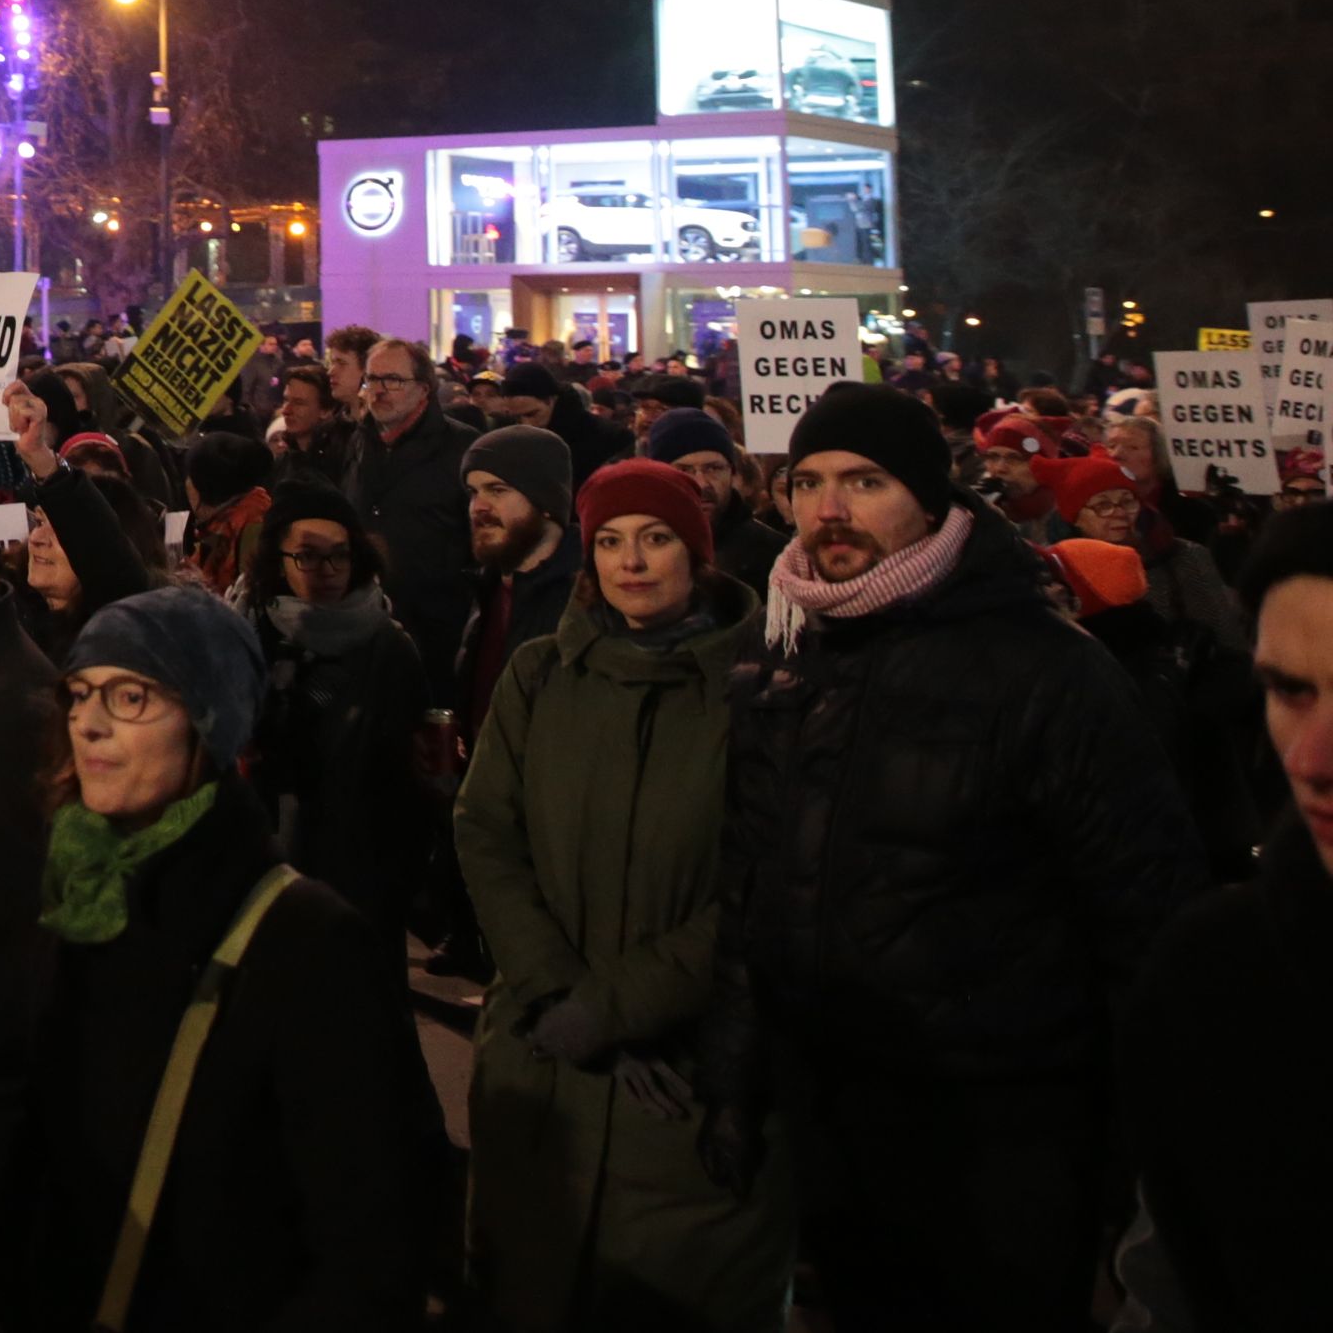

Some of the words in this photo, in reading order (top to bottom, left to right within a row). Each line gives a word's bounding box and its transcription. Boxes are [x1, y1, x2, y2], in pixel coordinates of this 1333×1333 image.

[184, 280, 254, 352] LASST
[169, 300, 238, 373] NAZIS
[760, 320, 836, 340] OMAS
[152, 322, 223, 393] NICHT
[754, 357, 847, 377] GEGEN
[140, 345, 206, 410] REGIEREN
[1175, 370, 1242, 389] OMAS
[1172, 404, 1254, 423] GEGEN
[1171, 438, 1267, 458] RECHTS
